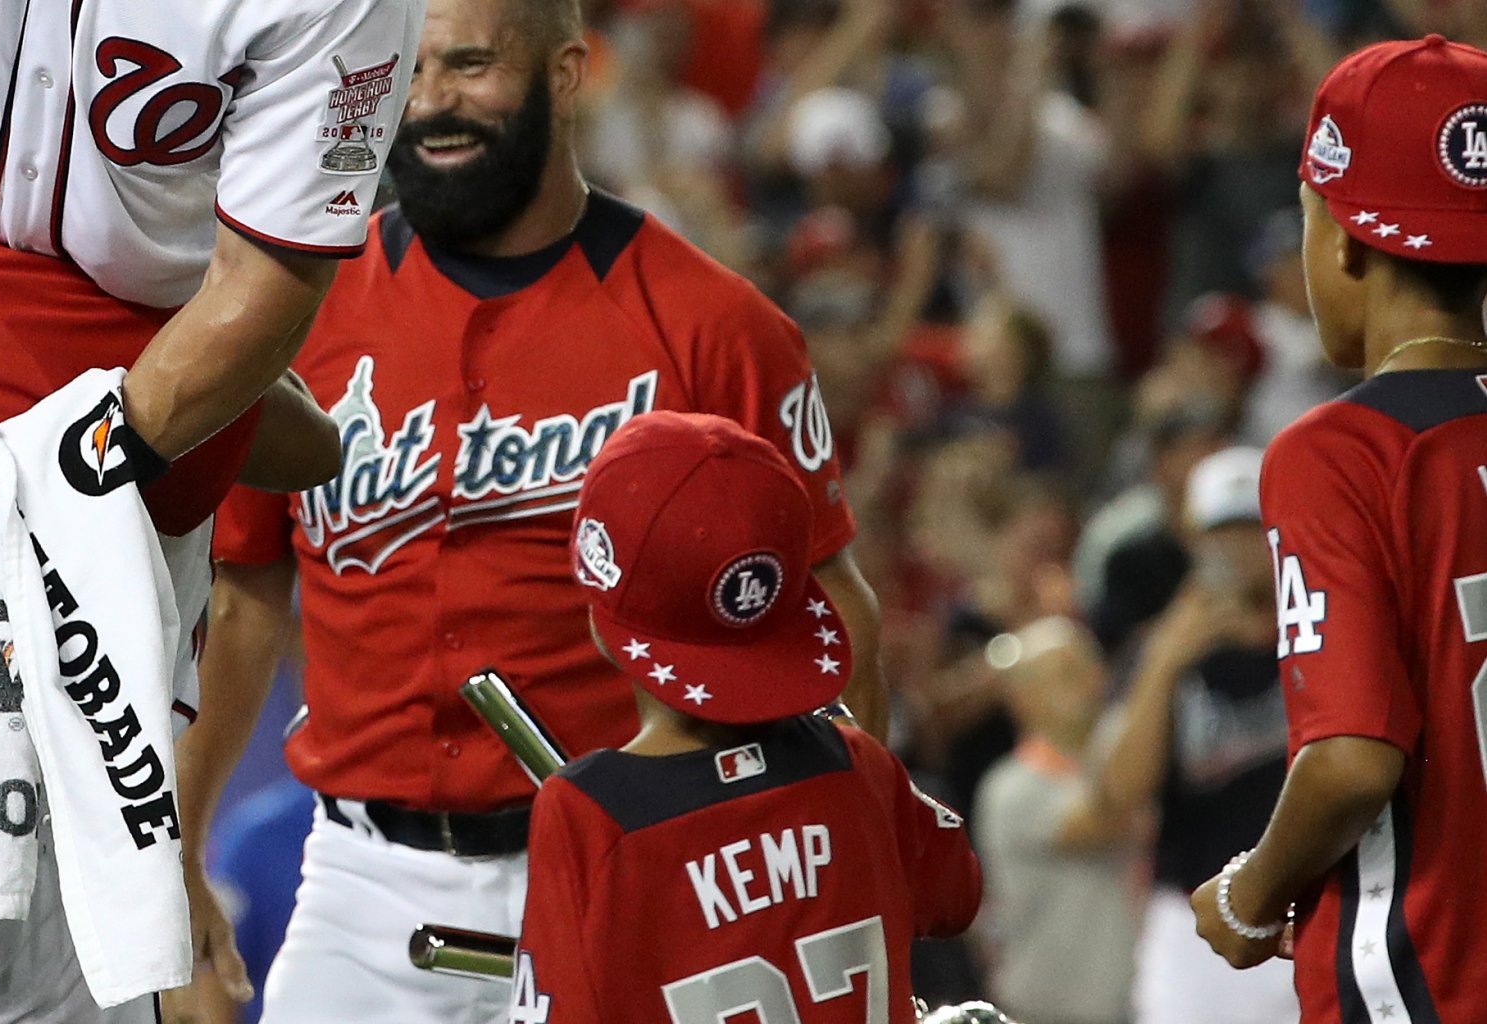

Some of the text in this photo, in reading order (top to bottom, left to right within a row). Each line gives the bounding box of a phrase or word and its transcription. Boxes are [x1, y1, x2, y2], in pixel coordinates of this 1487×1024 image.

[88, 36, 245, 166] W
[329, 77, 393, 109] HOME RUN
[337, 98, 379, 123] DERBY
[322, 127, 384, 138] 20 18
[325, 205, 361, 217] Majestic
[734, 570, 768, 612] LA
[29, 531, 182, 851] TORADE
[685, 824, 832, 930] KEMP
